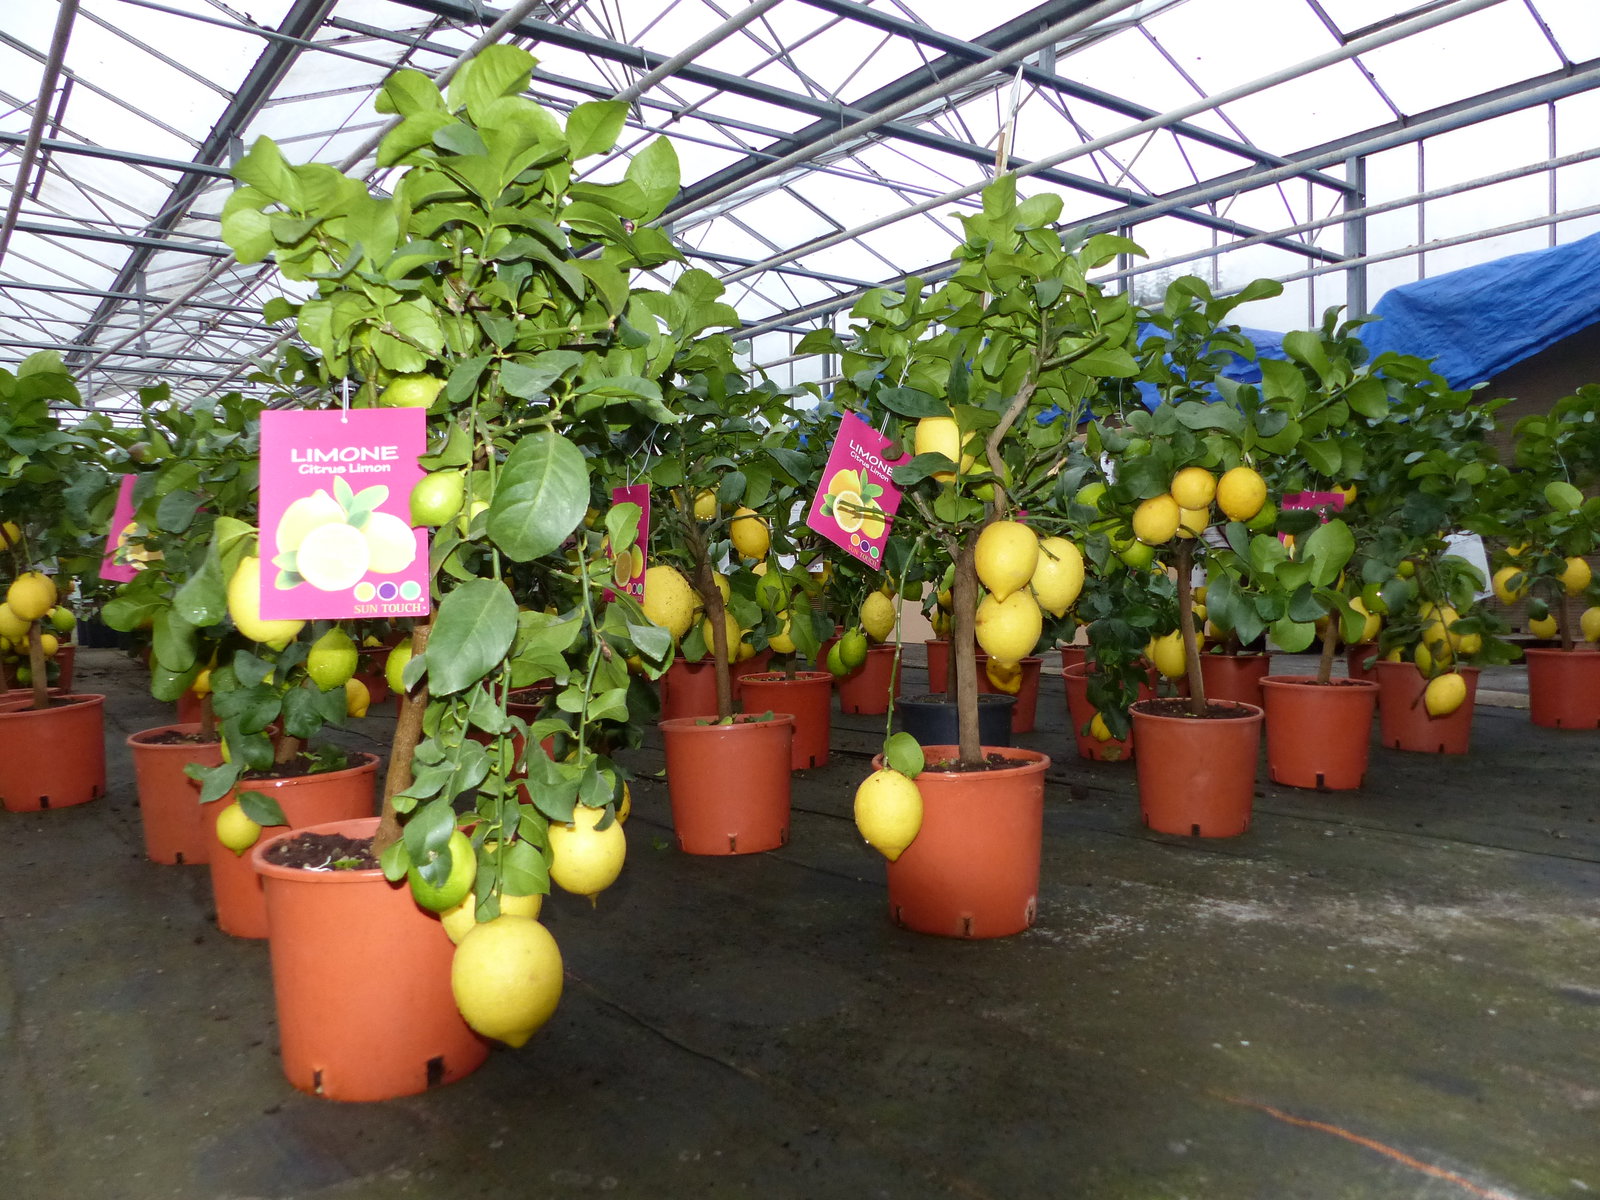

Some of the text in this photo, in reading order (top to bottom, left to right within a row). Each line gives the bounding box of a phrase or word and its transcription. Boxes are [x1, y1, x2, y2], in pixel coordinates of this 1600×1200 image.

[290, 445, 400, 463] LIMONE
[849, 439, 893, 477] LIMONE
[298, 463, 391, 474] Citrus Limon
[850, 450, 889, 482] Citrus Limon
[353, 602, 421, 614] SUN TOUCH
